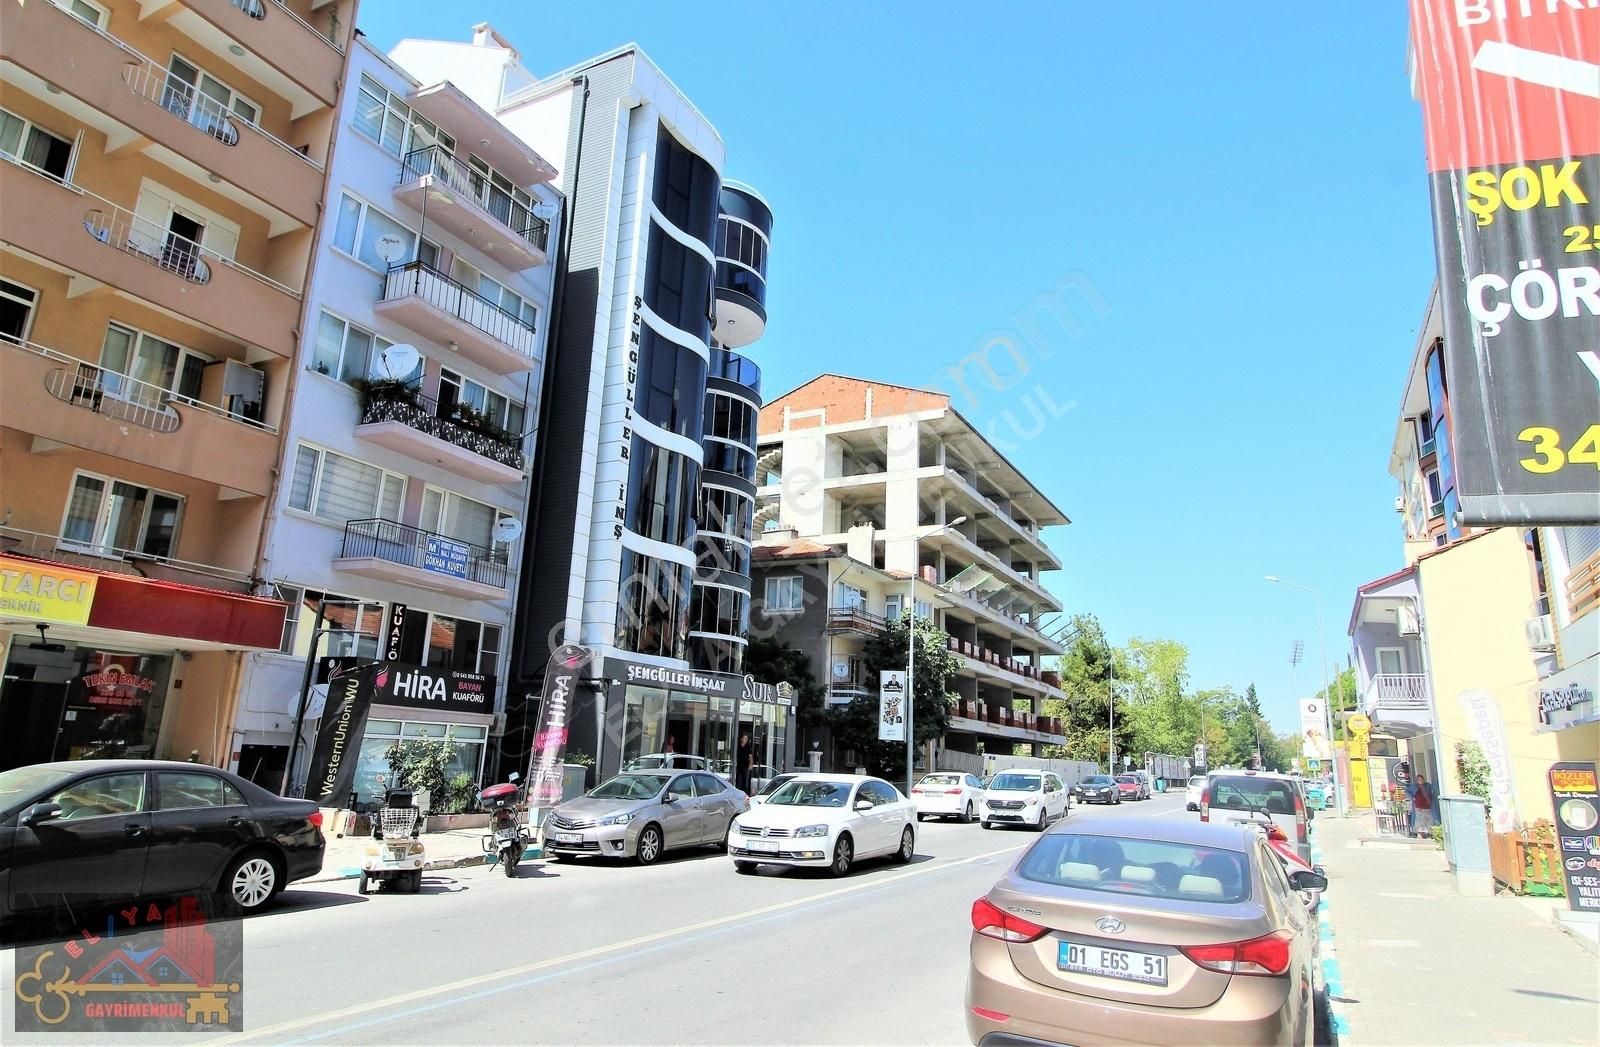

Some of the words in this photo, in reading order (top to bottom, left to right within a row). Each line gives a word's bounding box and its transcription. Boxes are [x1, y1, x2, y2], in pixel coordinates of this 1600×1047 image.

[1465, 161, 1589, 226] ŞOK
[621, 295, 642, 461] ŞENGÜLLER
[393, 669, 447, 702] HİRA
[458, 681, 482, 692] BAYAN
[627, 664, 690, 686] ŞENGÜLLER
[691, 673, 726, 693] İNŞAAT
[452, 691, 485, 703] KUAFÖRÜ
[546, 675, 572, 728] HİRA
[1069, 946, 1086, 965] 01
[1100, 950, 1129, 971] EGS
[1143, 956, 1163, 977] 51
